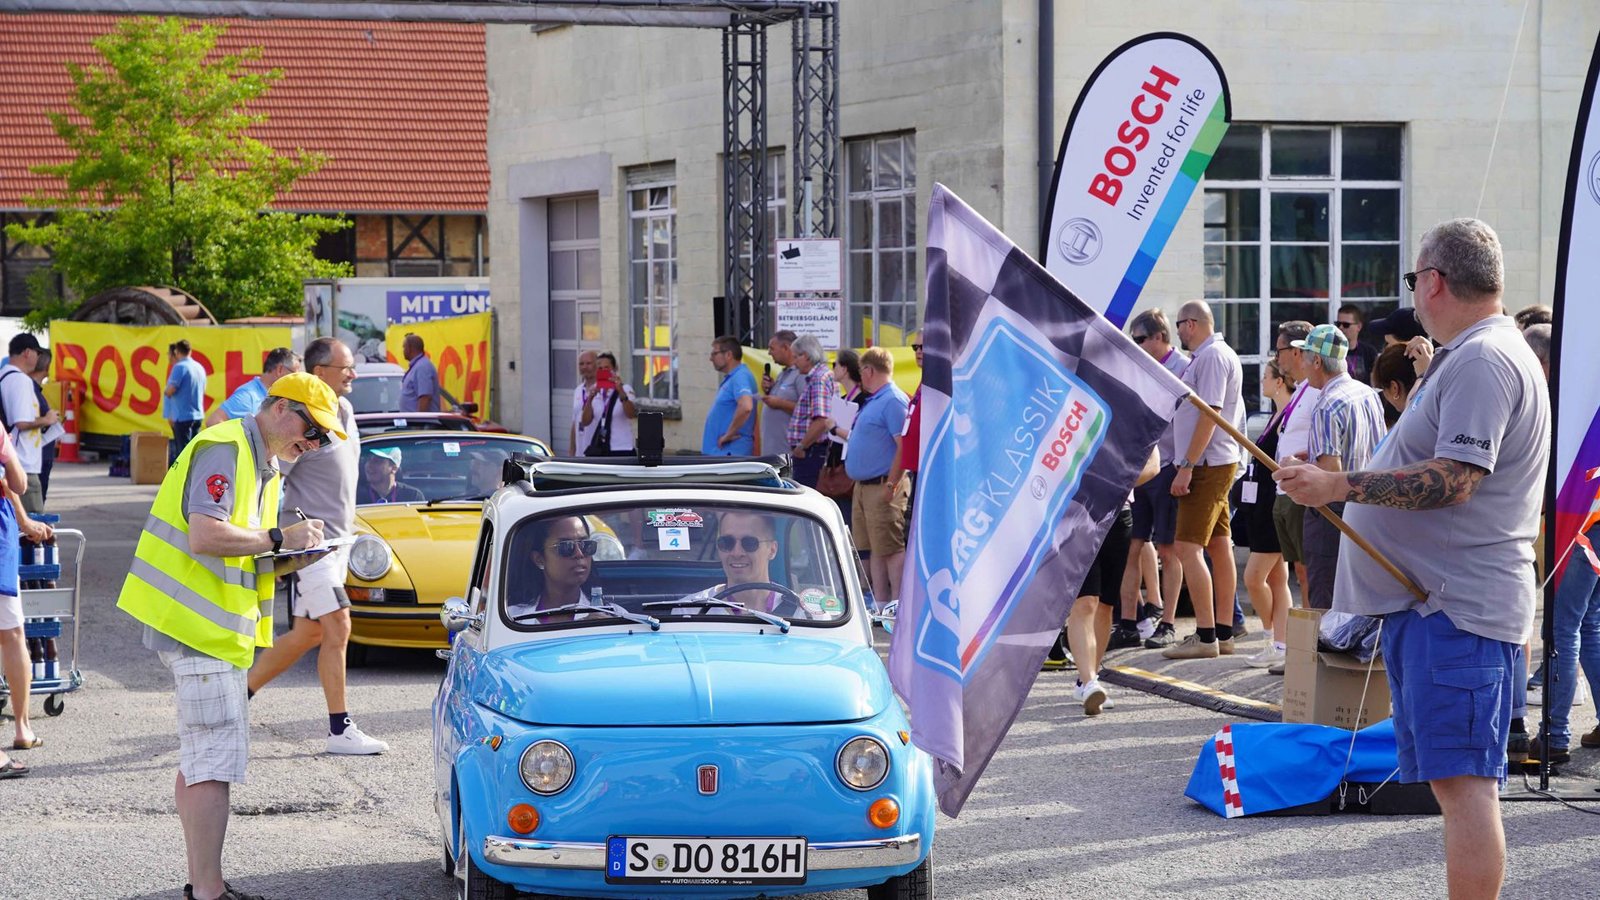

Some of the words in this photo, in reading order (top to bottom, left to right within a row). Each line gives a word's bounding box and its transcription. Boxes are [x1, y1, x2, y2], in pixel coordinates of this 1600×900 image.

[1087, 65, 1181, 207] BOSCH
[1126, 142, 1177, 221] Invented
[1167, 115, 1191, 145] for
[1180, 87, 1206, 121] life
[400, 295, 445, 314] MIT
[979, 376, 1064, 508] KLASSIK
[1041, 399, 1089, 473] BOSCH
[1450, 433, 1491, 451] Bosch
[669, 538, 680, 548] 4
[613, 861, 621, 871] D
[629, 842, 650, 872] S
[671, 843, 714, 873] DO
[721, 843, 802, 874] 816H
